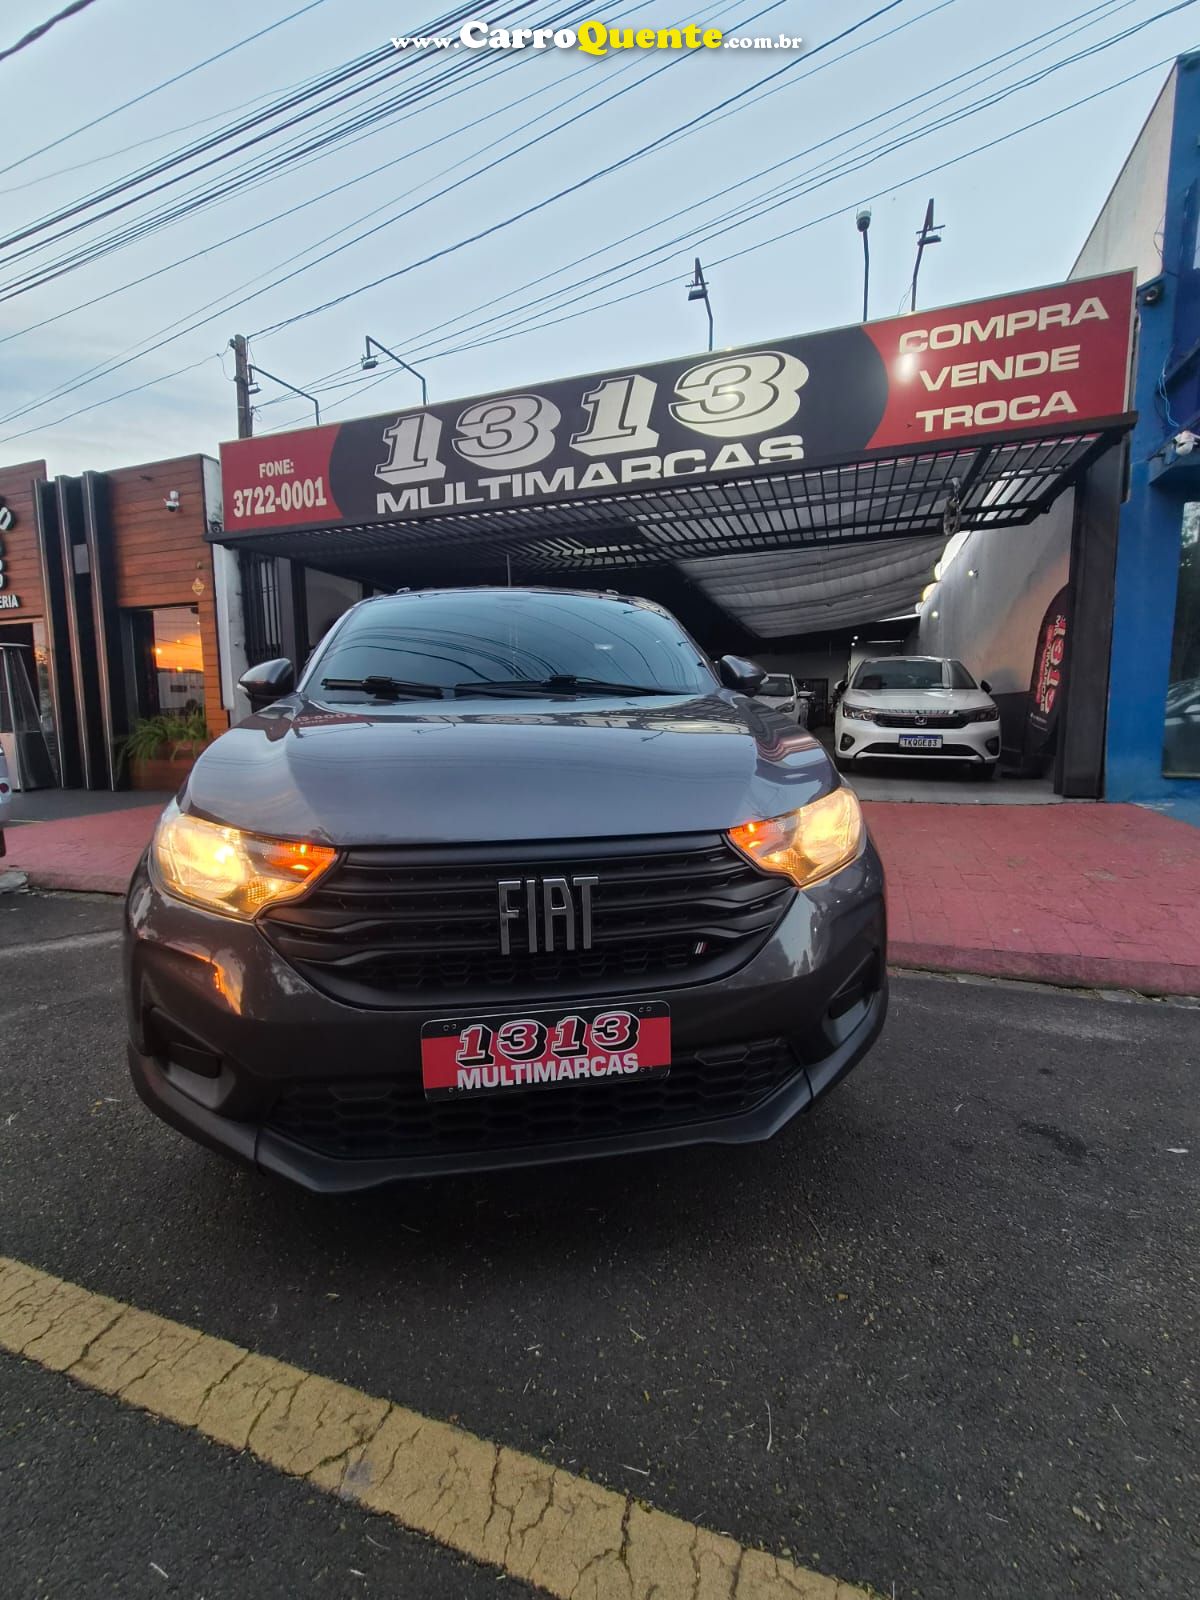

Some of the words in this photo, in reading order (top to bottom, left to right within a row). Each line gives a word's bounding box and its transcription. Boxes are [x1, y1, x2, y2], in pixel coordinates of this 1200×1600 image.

[899, 297, 1109, 353] COMPRA
[919, 344, 1081, 392] VENDE
[374, 350, 810, 485] 1313
[916, 390, 1078, 433] TROCA
[258, 458, 295, 479] FONE:
[376, 434, 805, 515] MULTIMARCAS
[233, 476, 327, 518] 3722-0001
[498, 876, 599, 955] FIAT
[456, 1010, 641, 1069] 1313
[457, 1052, 639, 1090] MULTIMARCAS
